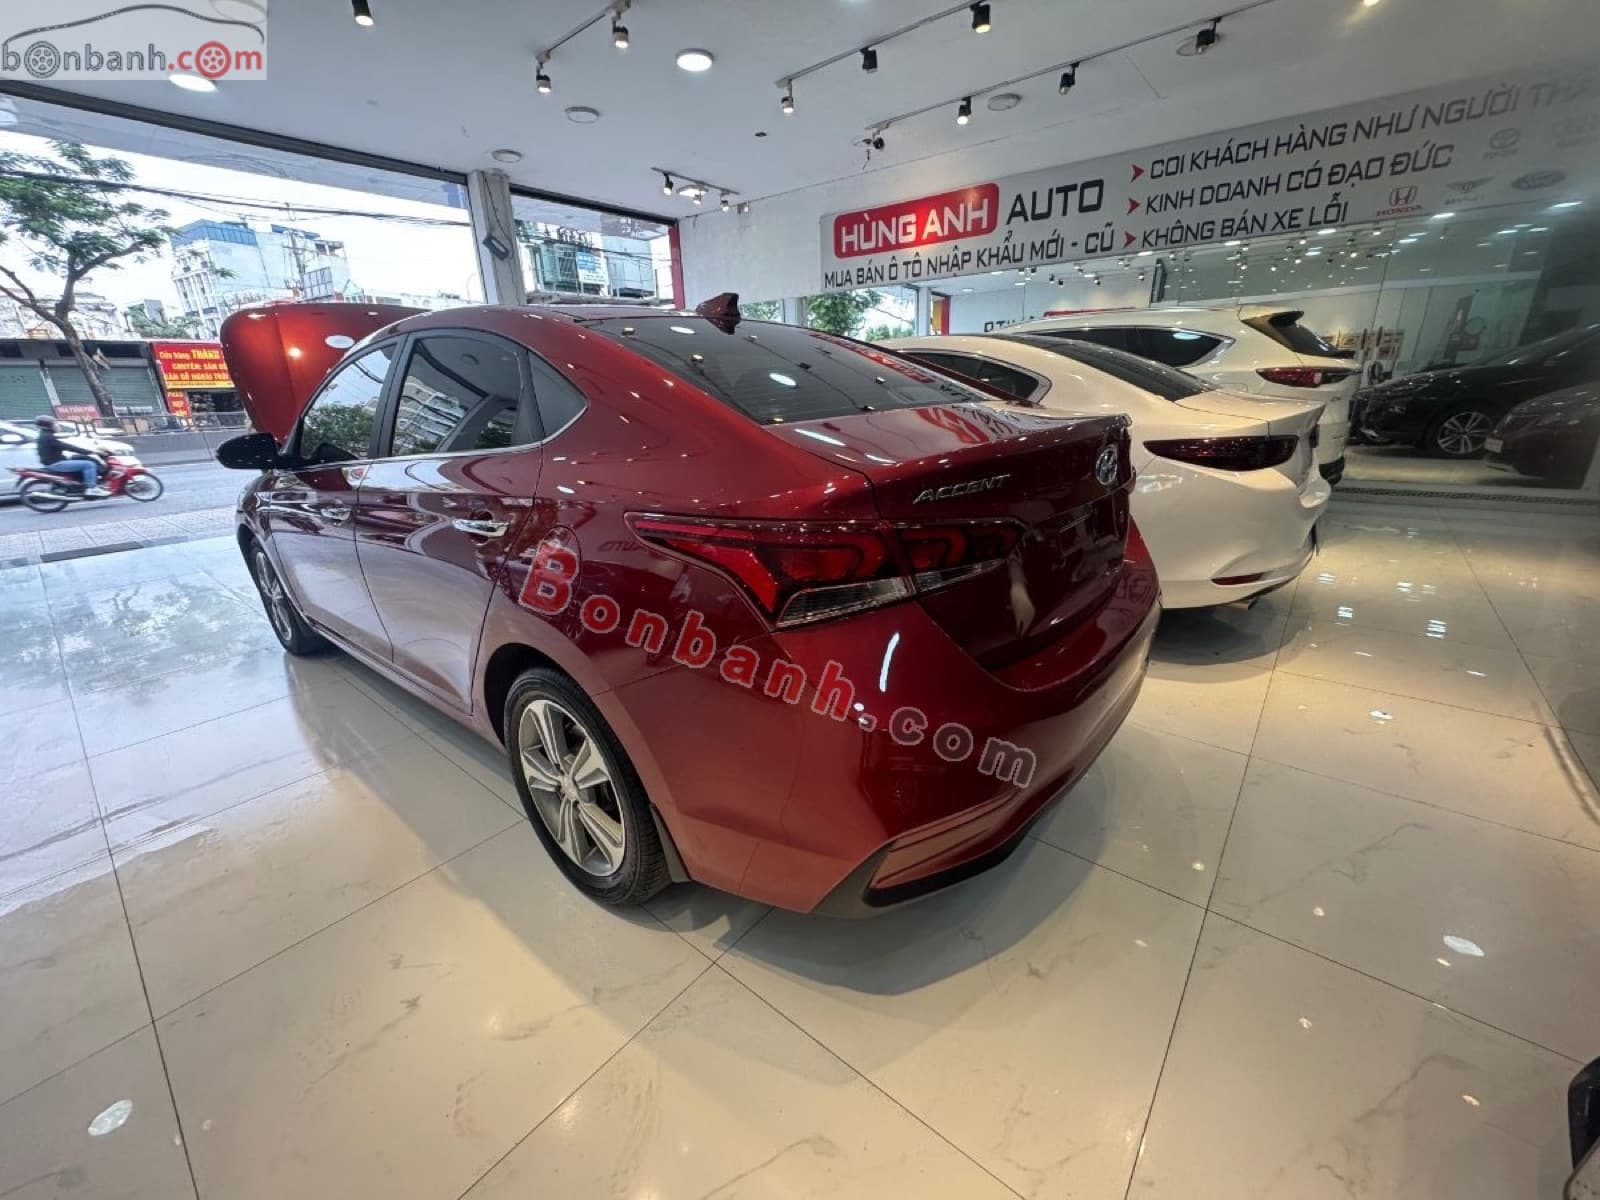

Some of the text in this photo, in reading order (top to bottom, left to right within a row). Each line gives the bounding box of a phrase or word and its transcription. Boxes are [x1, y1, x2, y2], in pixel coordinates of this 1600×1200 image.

[1150, 154, 1185, 180] COI
[1189, 137, 1270, 172] KHÁCH
[1273, 122, 1348, 157] HÀNG
[1352, 103, 1420, 143] NHƯ
[1421, 82, 1521, 129] NGƯỜI
[1145, 139, 1455, 215] KINH DOANH CÓ ĐẠO ĐỨC
[1376, 204, 1424, 217] HONDA
[841, 179, 1104, 253] HÙNG ANH AUTO
[1141, 192, 1349, 248] KHÔNG BÁN XE LỖI
[824, 271, 853, 289] MUA
[856, 258, 885, 284] BÁN
[888, 255, 899, 278] Ô
[903, 252, 922, 277] TÔ
[927, 247, 971, 277] NHẬP
[976, 230, 1024, 267] KHẨU
[1030, 228, 1065, 261] MỚI
[1084, 221, 1115, 253] CŨ
[913, 473, 1012, 504] ACCENT
